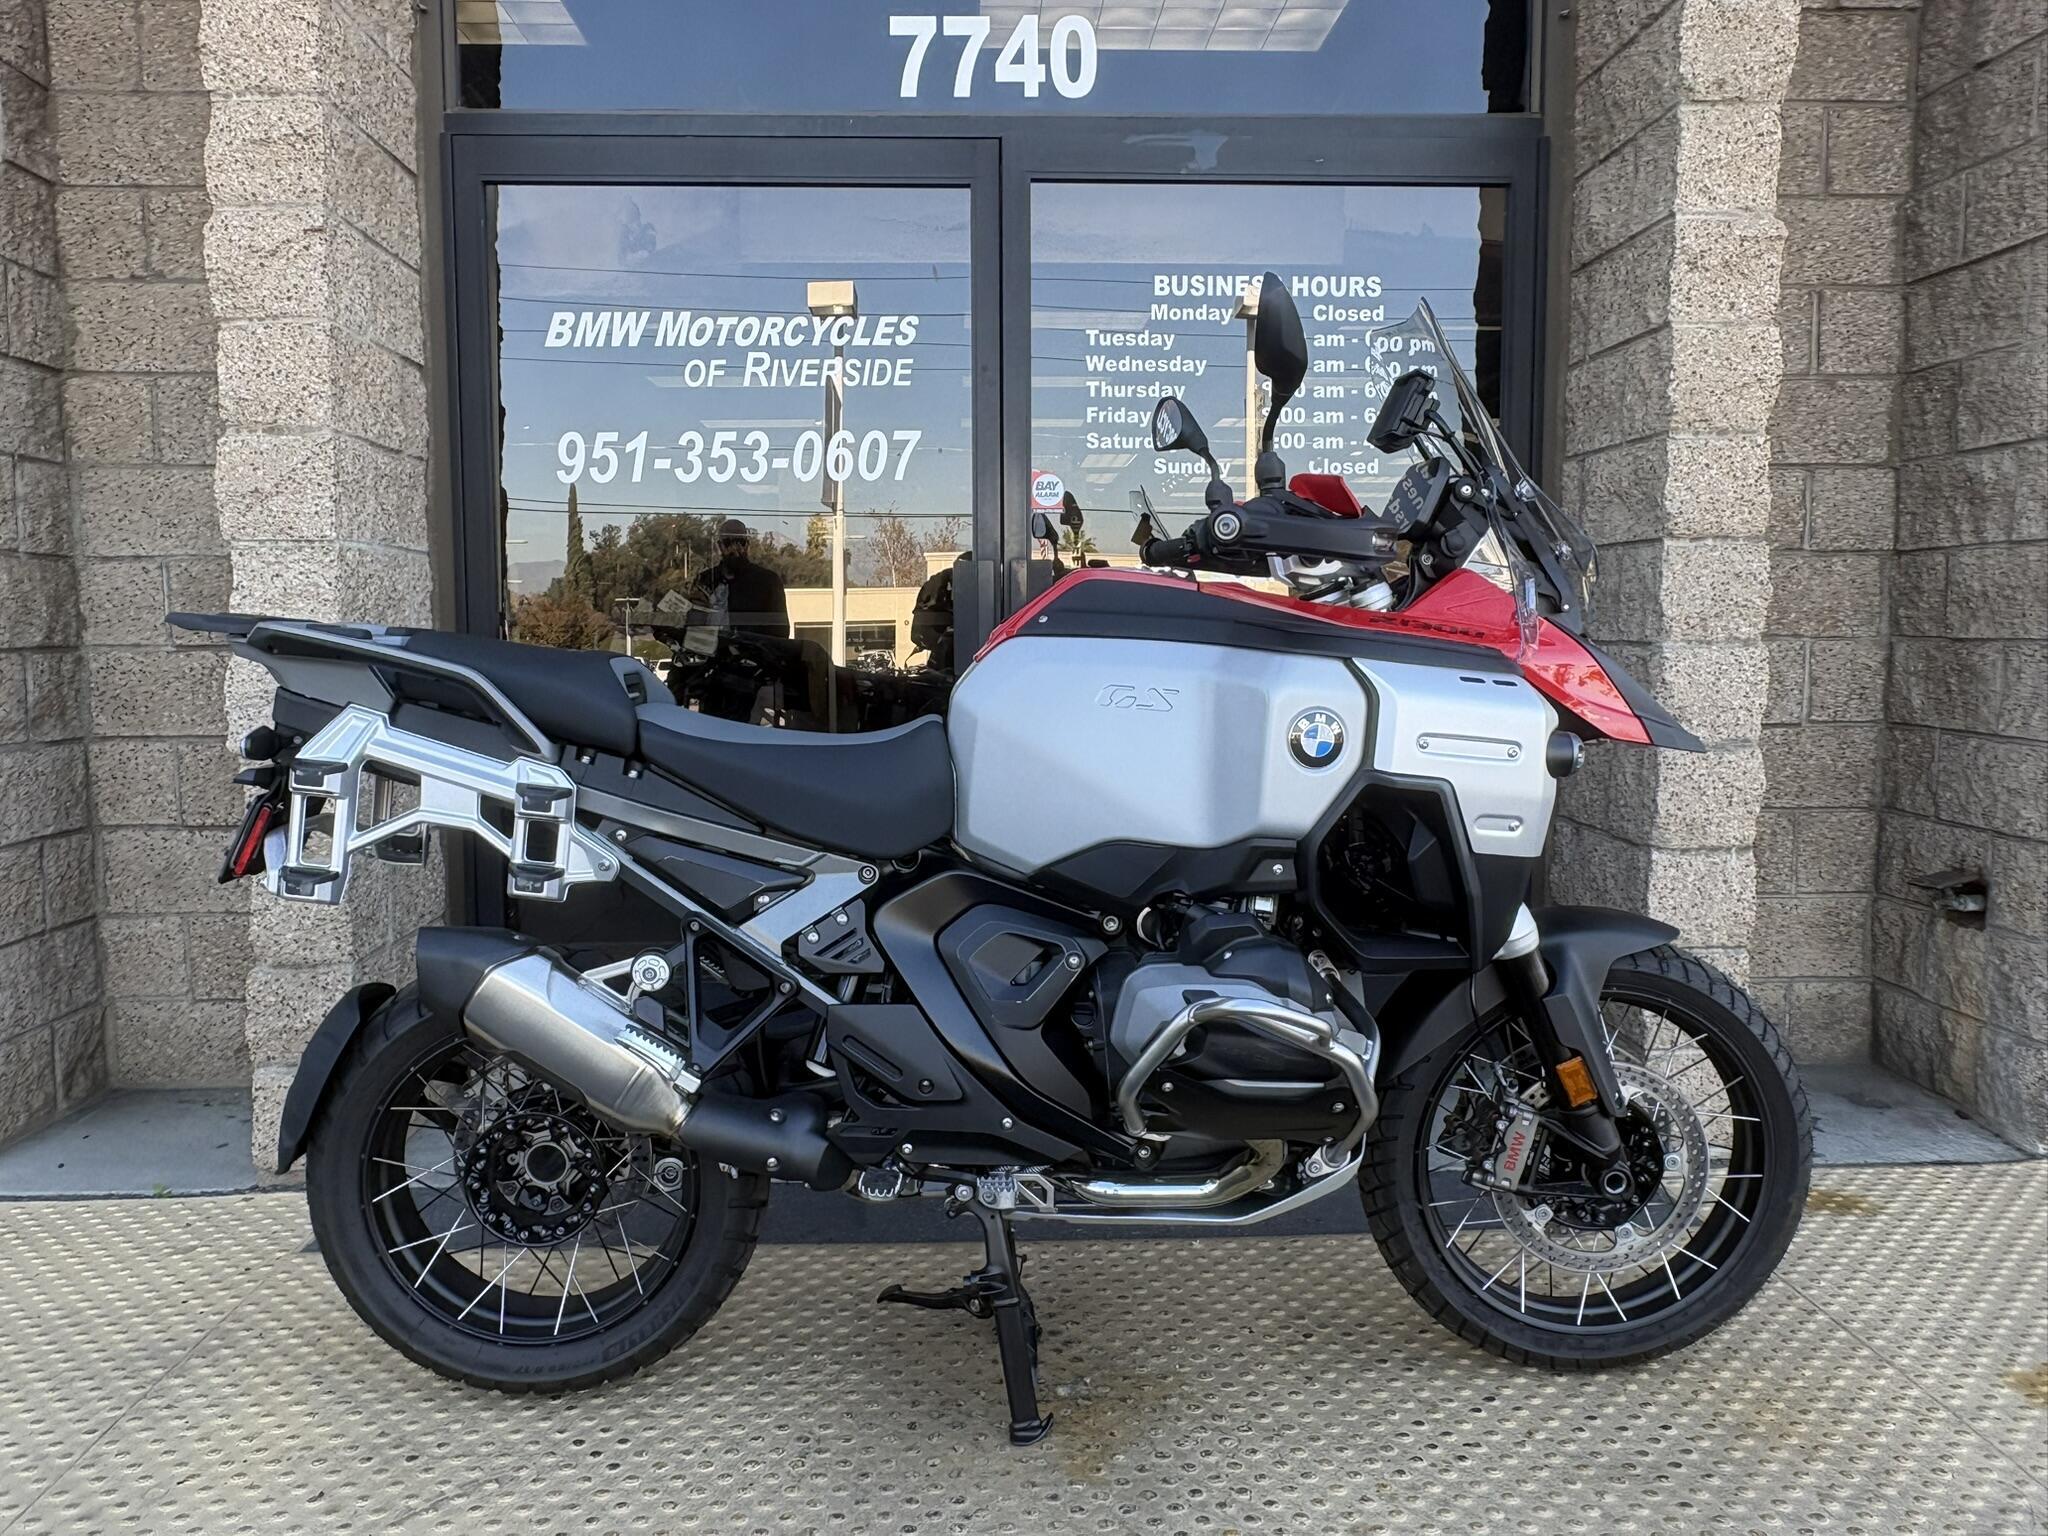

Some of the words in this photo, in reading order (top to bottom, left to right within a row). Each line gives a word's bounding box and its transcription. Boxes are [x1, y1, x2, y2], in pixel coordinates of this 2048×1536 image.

[889, 14, 1098, 98] 7740
[1154, 274, 1264, 297] BUSINES
[1291, 275, 1382, 298] HOURS
[1150, 303, 1234, 326] Monday
[1312, 304, 1385, 322] Closed
[543, 311, 653, 348] BMW
[654, 311, 920, 348] MOTORCYCLES
[1085, 329, 1175, 351] Tuesday
[1312, 334, 1345, 348] am
[1408, 338, 1436, 357] pm
[683, 358, 727, 388] OF
[742, 350, 915, 388] RIVERSIDE
[1085, 355, 1207, 377] Wednesday
[1312, 359, 1345, 373] am
[1085, 381, 1186, 400] Thursday
[1312, 384, 1345, 399] am
[1086, 406, 1152, 427] Friday
[1312, 410, 1345, 424] am
[1086, 432, 1154, 450] Saturd
[1311, 436, 1345, 450] am
[555, 429, 922, 484] 951-353-0607
[1153, 457, 1231, 477] Sundy
[1308, 457, 1379, 475] Closed
[1035, 480, 1060, 491] BAY
[1297, 713, 1342, 735] BMW
[1503, 1131, 1526, 1172] BMW
